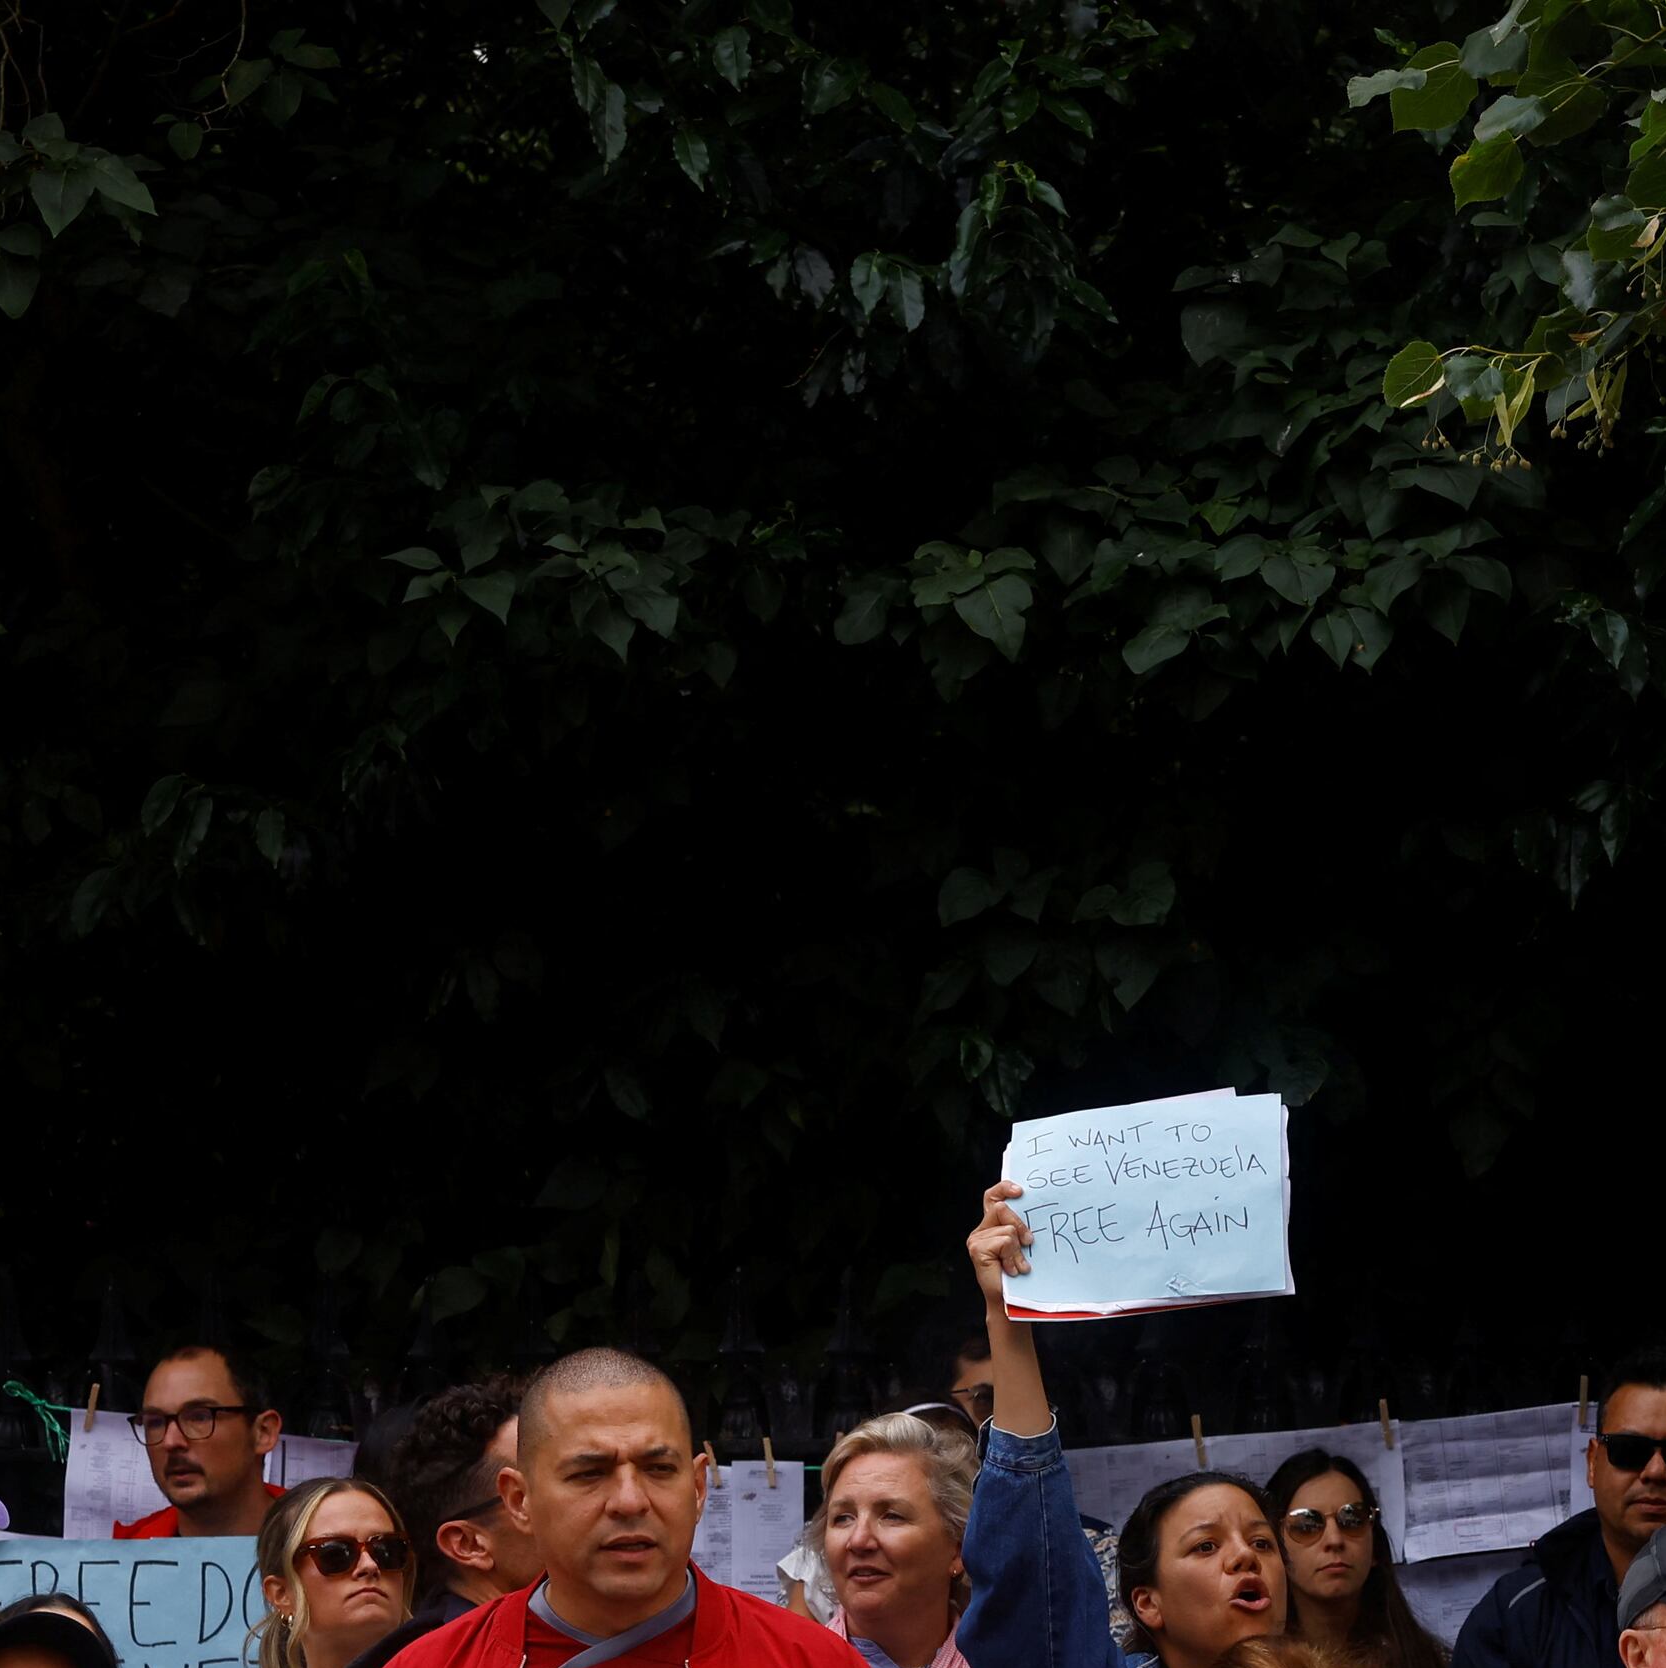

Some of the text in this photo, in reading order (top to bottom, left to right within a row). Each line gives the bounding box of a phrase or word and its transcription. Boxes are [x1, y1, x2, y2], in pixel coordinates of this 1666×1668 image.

[1027, 1121, 1211, 1158] I WANT TO
[1026, 1164, 1093, 1189] SEE
[1023, 1202, 1124, 1263] FREE
